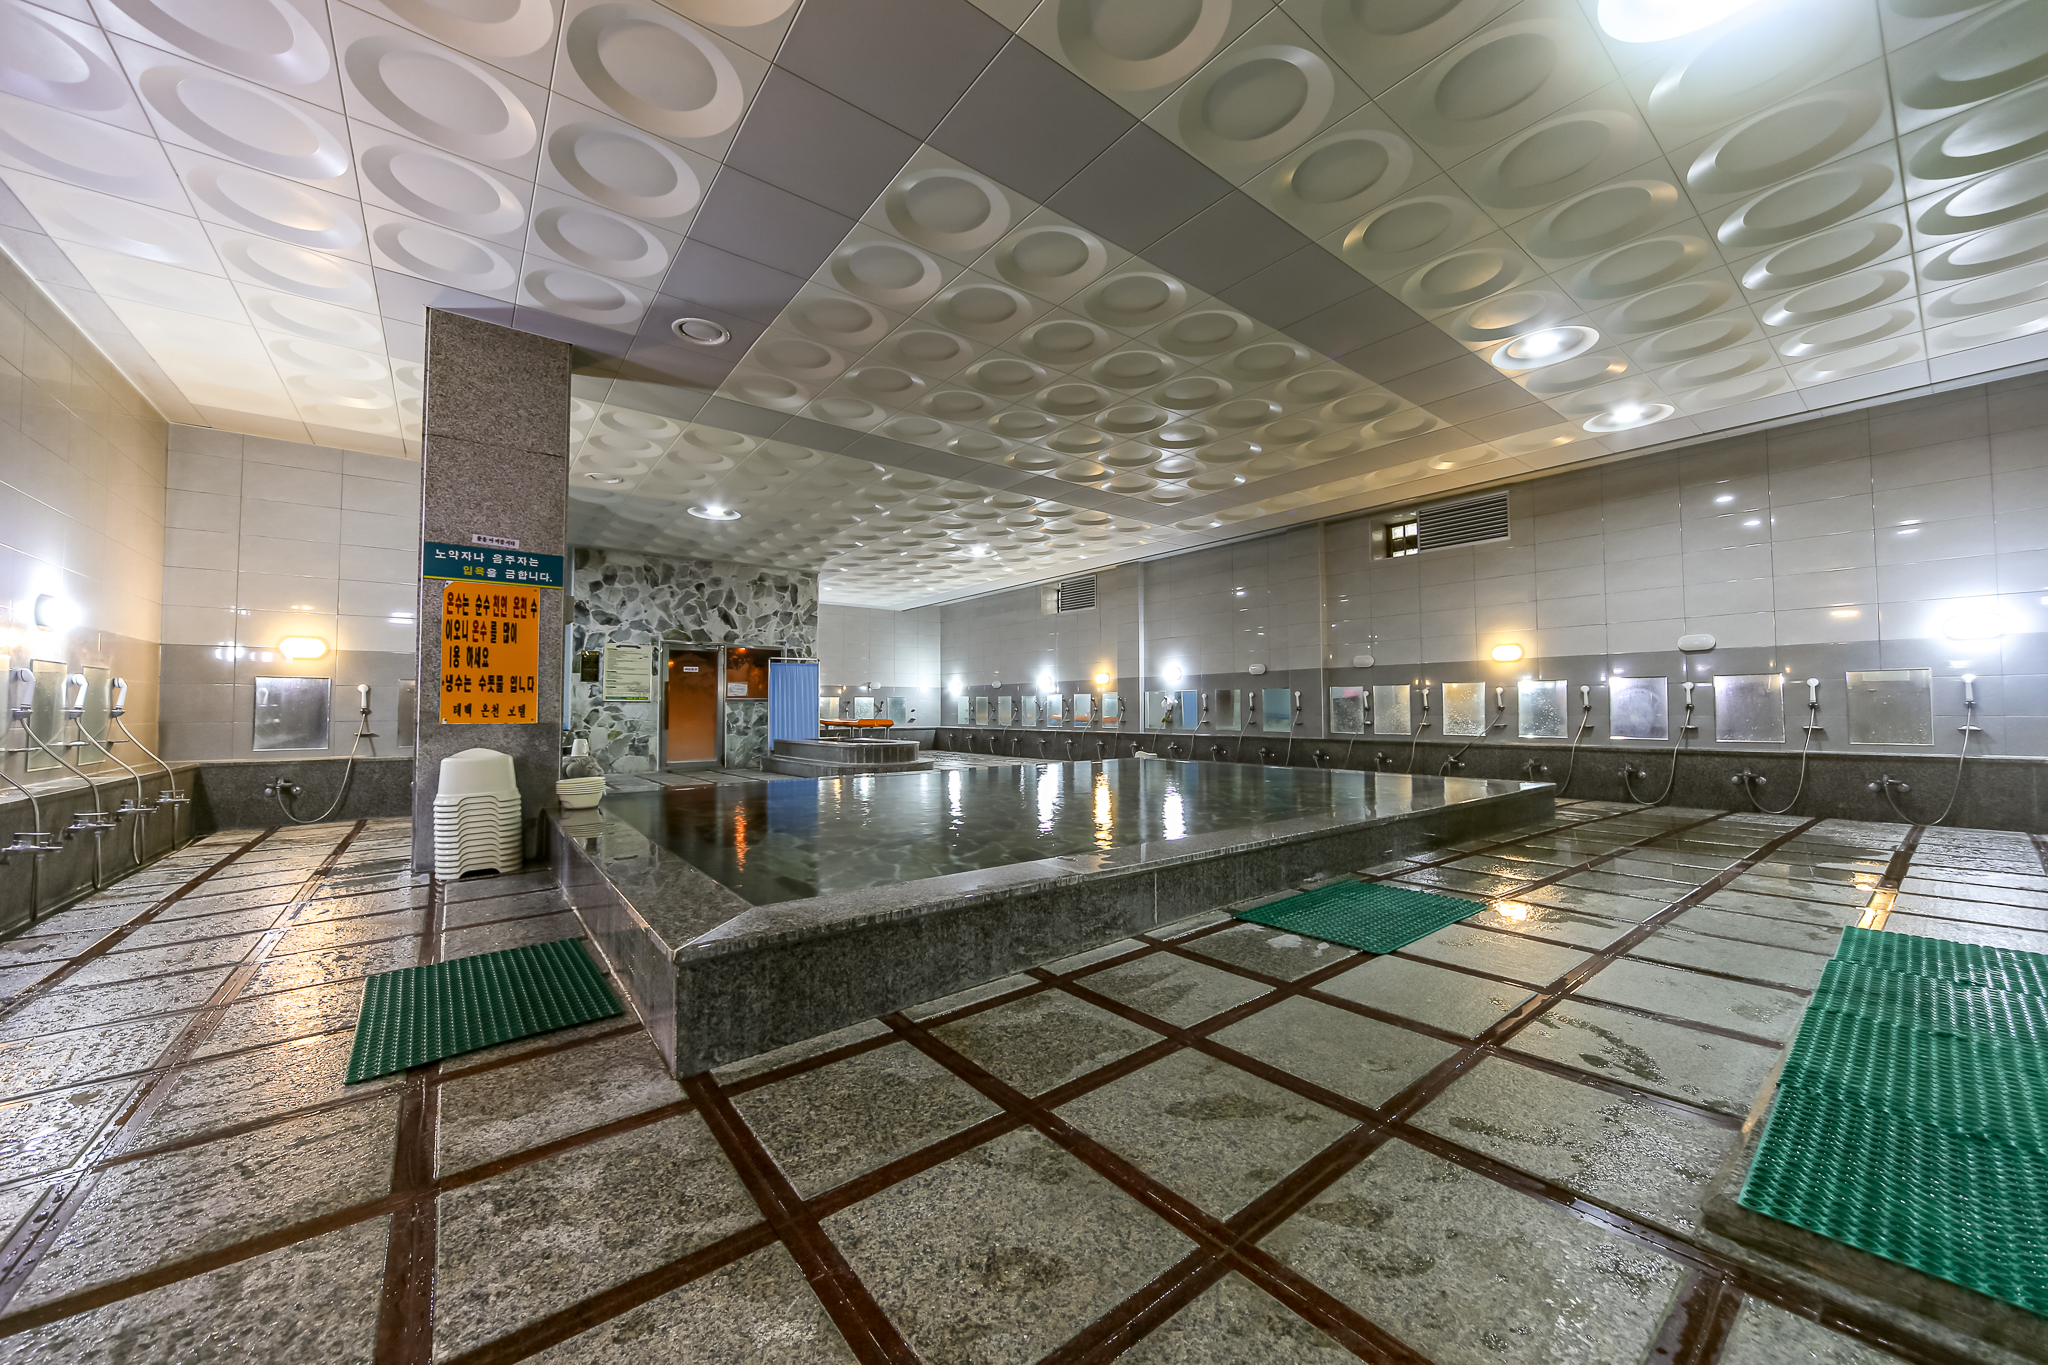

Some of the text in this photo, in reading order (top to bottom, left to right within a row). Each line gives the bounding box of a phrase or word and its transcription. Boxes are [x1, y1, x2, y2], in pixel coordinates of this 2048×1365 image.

[434, 549, 539, 567] 노약자나 음주자는
[463, 565, 553, 582] 입욕을 금합니다.
[447, 591, 469, 616] 온수는
[445, 618, 469, 642] 이오니
[503, 622, 518, 644] 많이
[445, 674, 535, 693] 냉수는 수돗물 입니다
[453, 702, 472, 718] 태백
[481, 703, 499, 718] 온천
